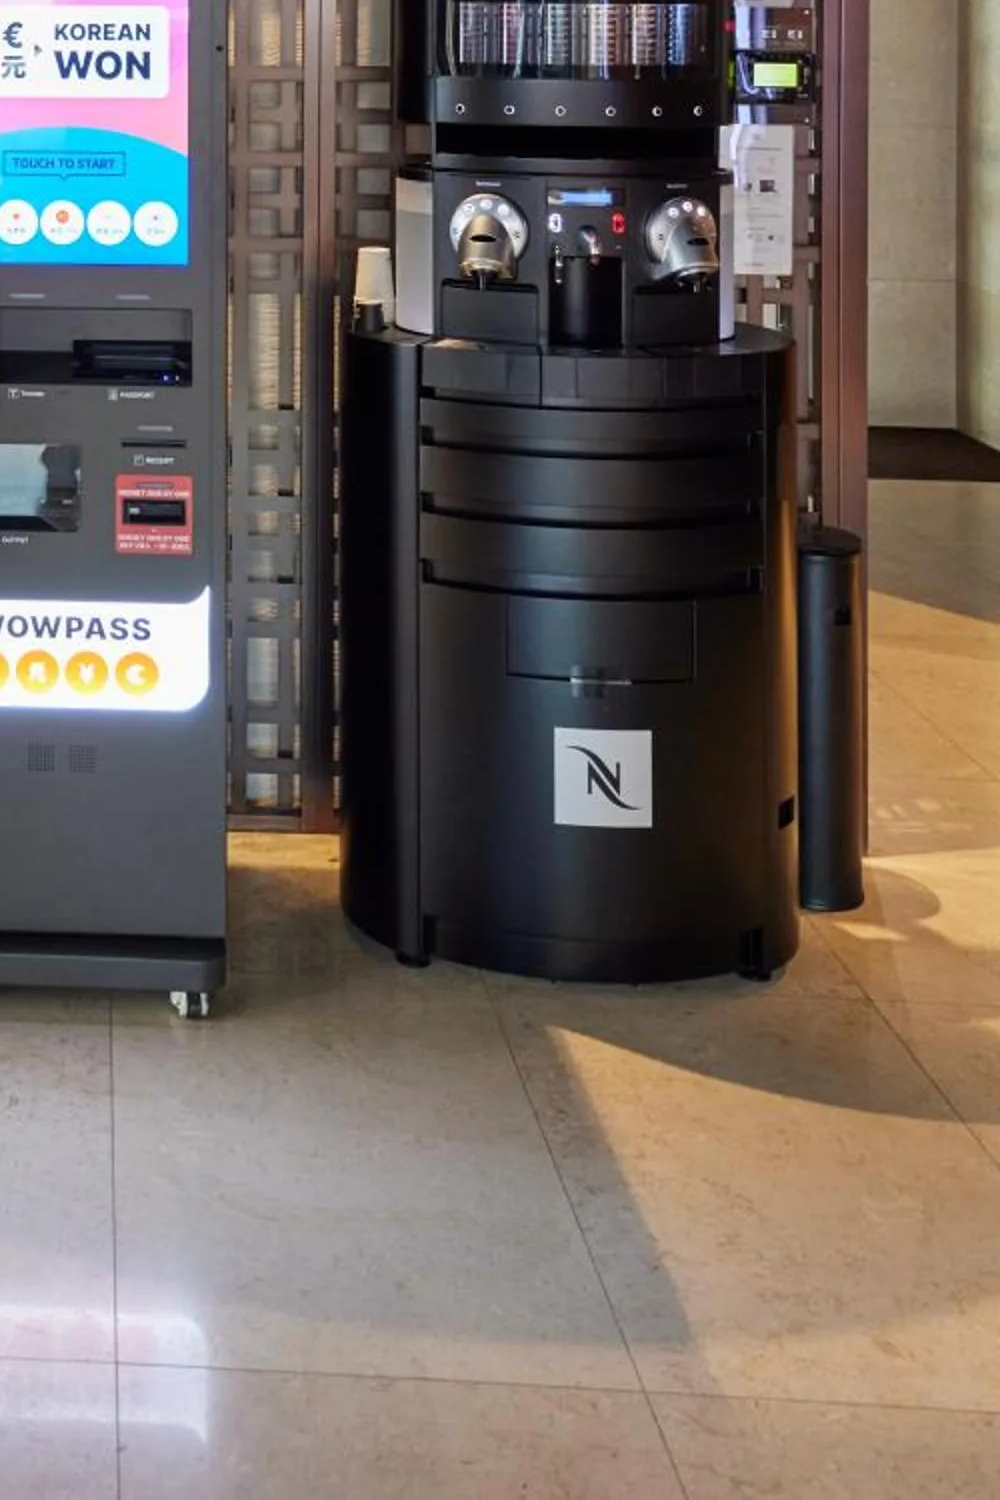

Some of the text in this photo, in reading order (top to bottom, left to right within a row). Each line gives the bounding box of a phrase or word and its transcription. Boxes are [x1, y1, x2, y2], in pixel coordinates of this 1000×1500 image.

[3, 21, 23, 48] €
[54, 23, 151, 41] KOREAN
[54, 50, 151, 80] WON
[12, 157, 116, 169] TOUCH TO START
